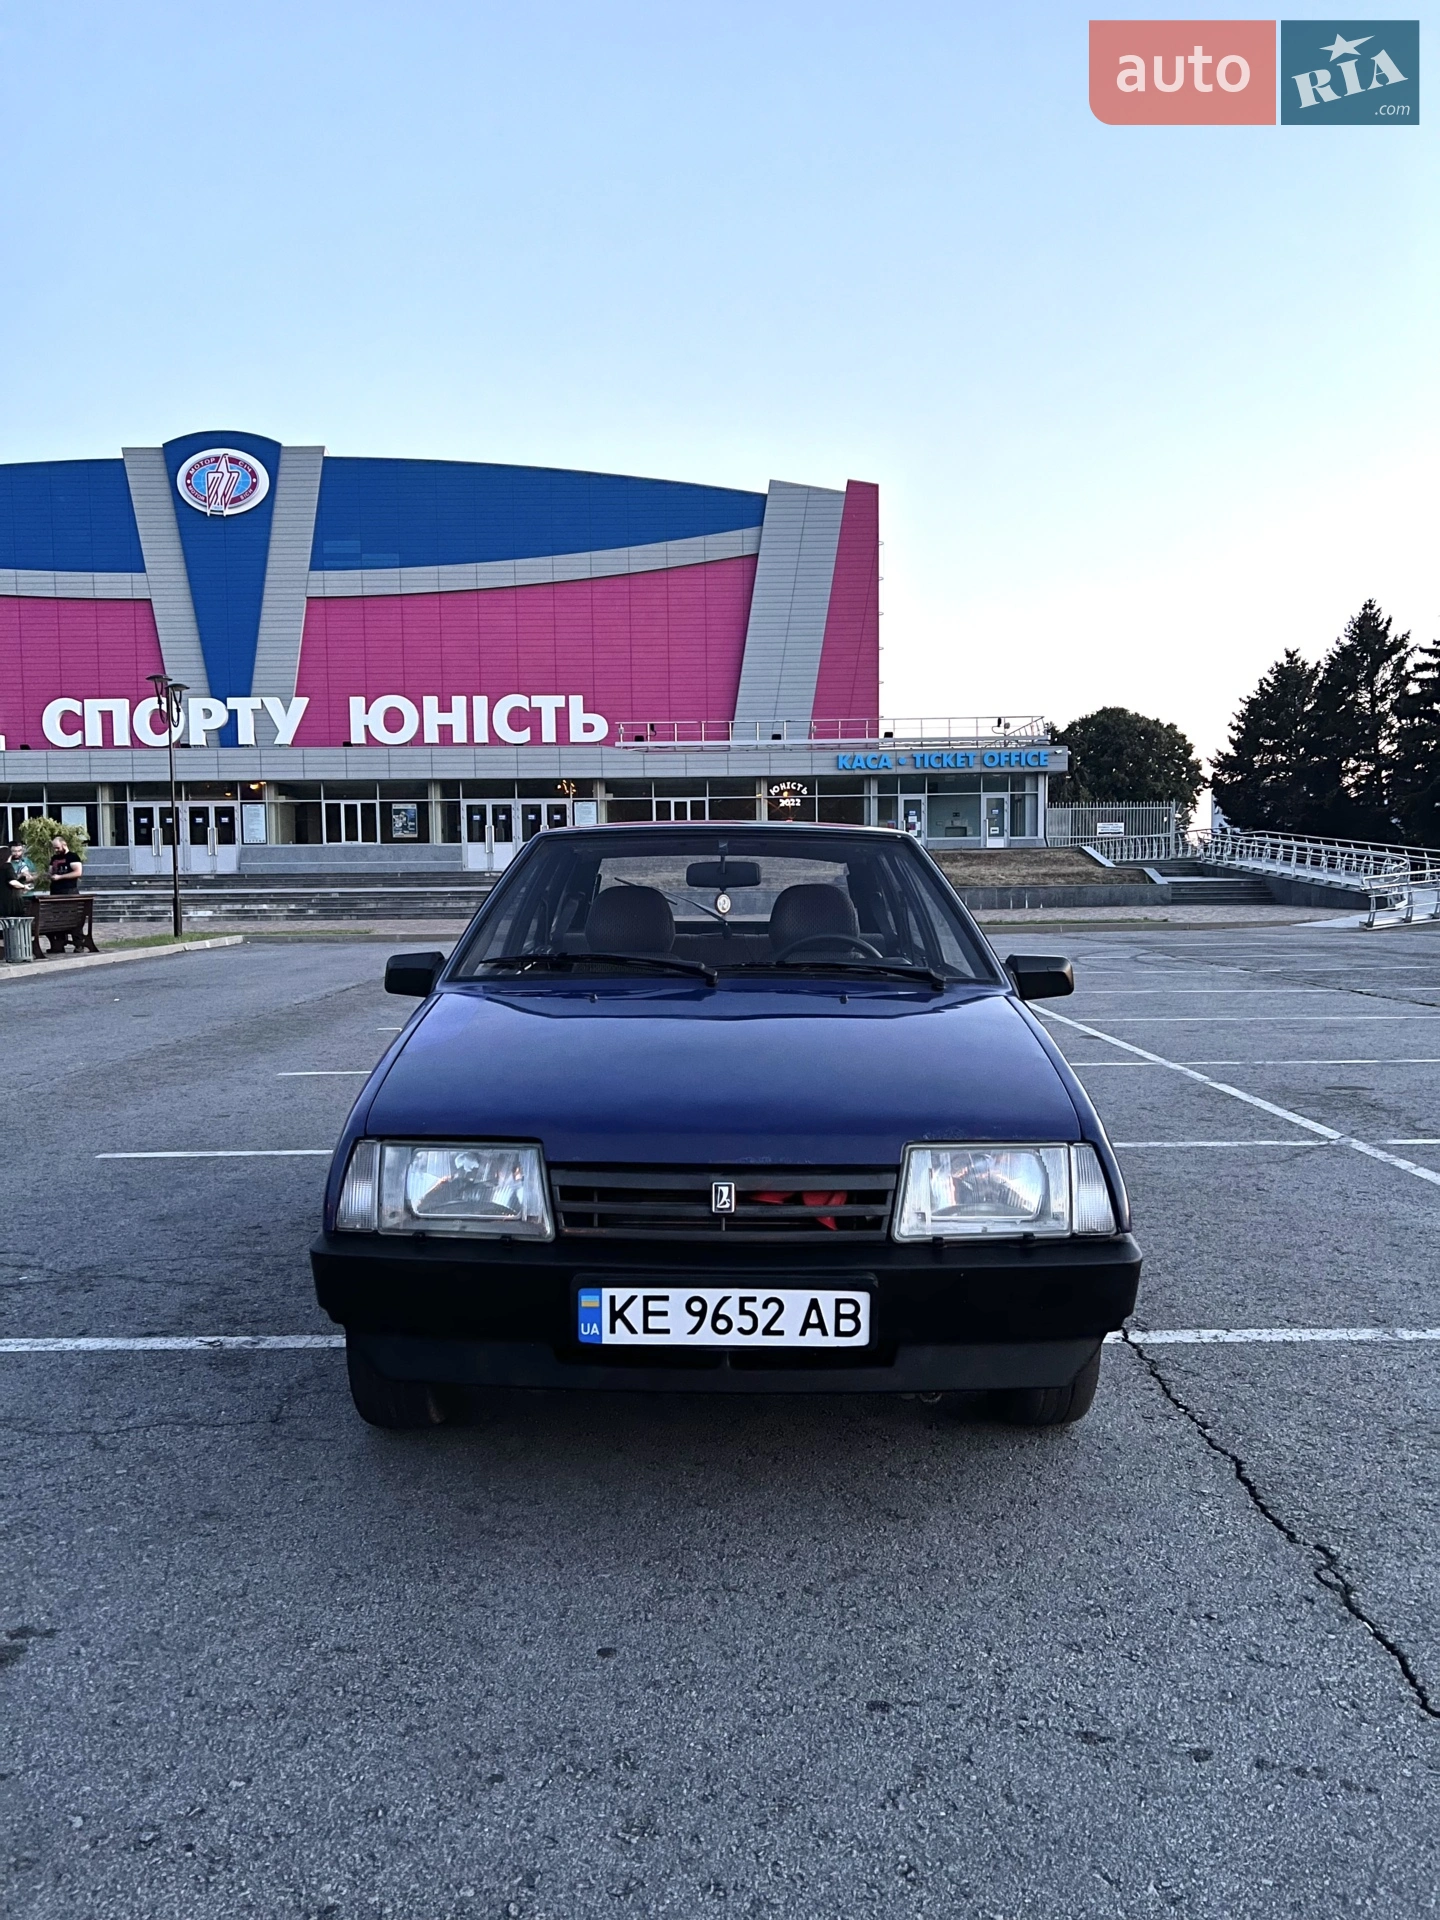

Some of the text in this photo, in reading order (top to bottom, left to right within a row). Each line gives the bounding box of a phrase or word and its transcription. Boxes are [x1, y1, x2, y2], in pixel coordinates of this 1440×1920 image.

[189, 457, 253, 475] МОТОР СІЧ
[188, 485, 205, 501] MOTOR
[42, 693, 609, 748] СПОРТУ ЮНІСТЬ
[837, 753, 892, 770] КАСА
[914, 751, 1049, 769] TICKET OFFICE
[769, 781, 808, 796] ЮНІСТЬ
[779, 798, 801, 807] 2022
[609, 1295, 862, 1337] KE 9652 AB
[581, 1323, 600, 1335] UA
